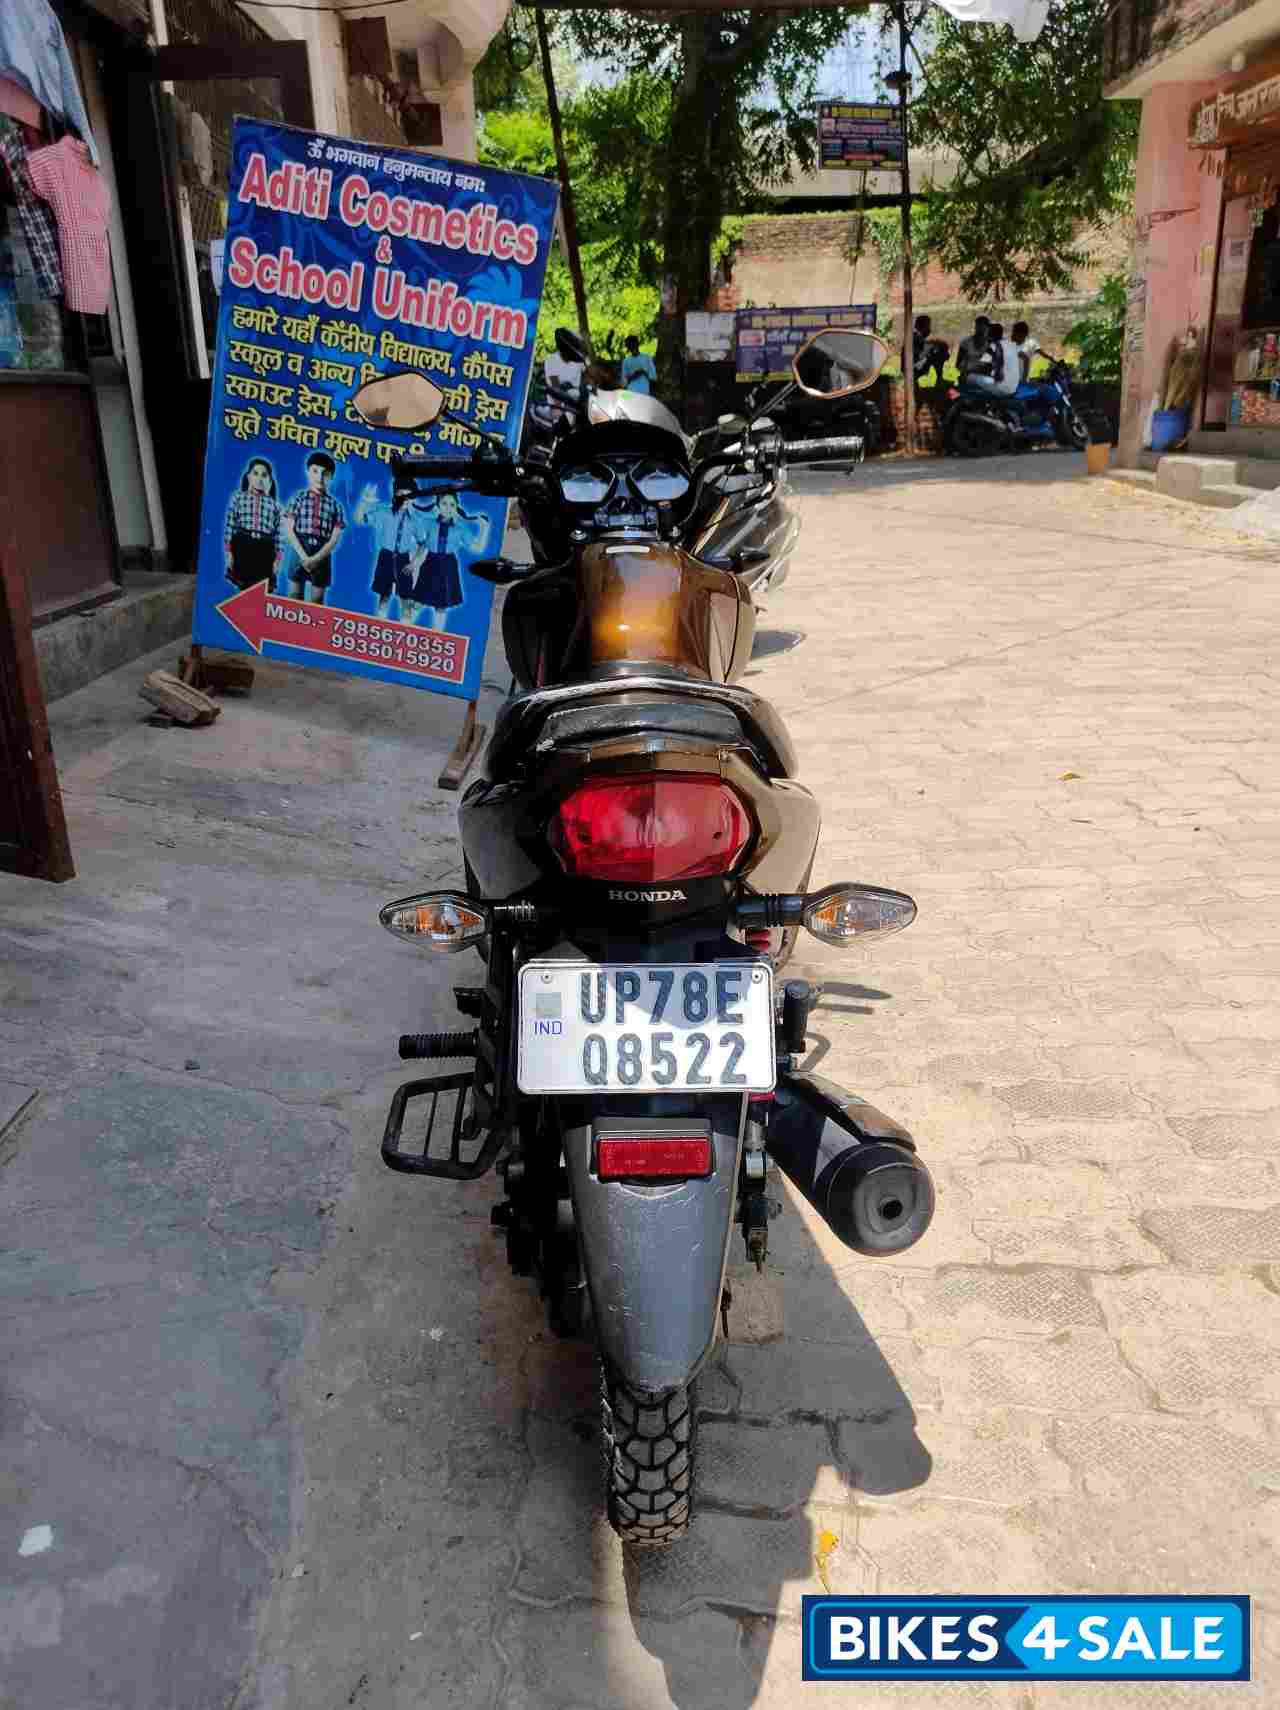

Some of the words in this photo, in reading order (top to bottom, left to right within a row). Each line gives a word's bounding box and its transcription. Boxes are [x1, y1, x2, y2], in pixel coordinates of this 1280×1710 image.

[326, 146, 380, 171] भगवान
[238, 153, 332, 220] Aditi
[340, 174, 538, 265] Cosmetics
[376, 235, 393, 264] &
[229, 236, 364, 312] School
[372, 267, 528, 349] Uniform
[232, 305, 279, 335] हमारे
[282, 314, 320, 344] यहाँ
[225, 374, 295, 408] स्काउट
[297, 384, 338, 420] ड्रेस,
[230, 340, 284, 377] स्कूल
[287, 352, 304, 376] व
[308, 358, 356, 387] अन्य
[475, 388, 510, 424] ड्रेस
[224, 408, 262, 441] जूते
[266, 414, 321, 449] उचित
[324, 430, 371, 463] मूल्य
[330, 634, 455, 673] 9935015920
[333, 616, 456, 657] 7985670355
[608, 889, 687, 902] HONDA
[580, 970, 745, 1025] UP78E
[534, 1020, 563, 1036] IND
[582, 1031, 748, 1086] Q8522
